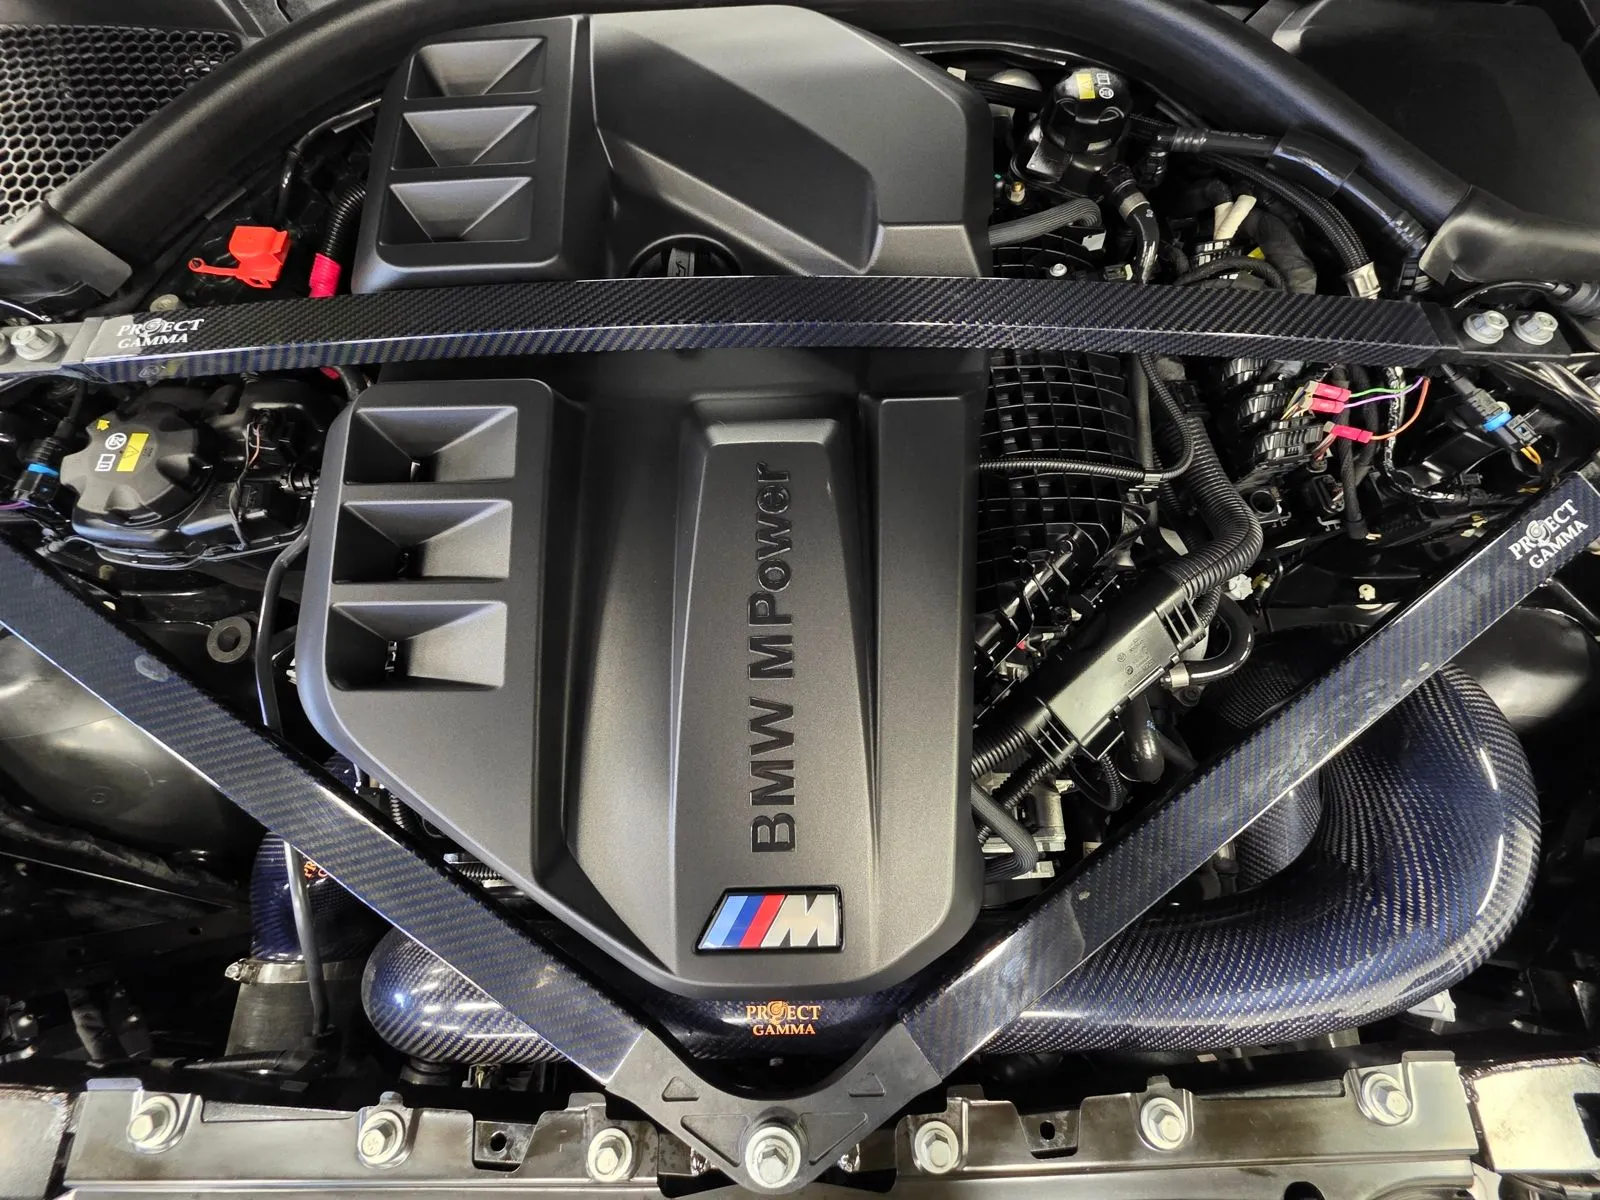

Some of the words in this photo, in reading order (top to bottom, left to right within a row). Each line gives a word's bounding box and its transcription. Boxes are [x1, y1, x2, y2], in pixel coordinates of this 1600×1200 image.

[116, 318, 204, 337] PROJECT
[118, 333, 188, 348] GAMMA
[1508, 499, 1578, 560] PROJECT
[1529, 520, 1589, 568] GAMMA
[749, 696, 796, 852] BMW
[745, 1001, 821, 1024] PROJECT
[752, 1024, 816, 1036] GAMMA
